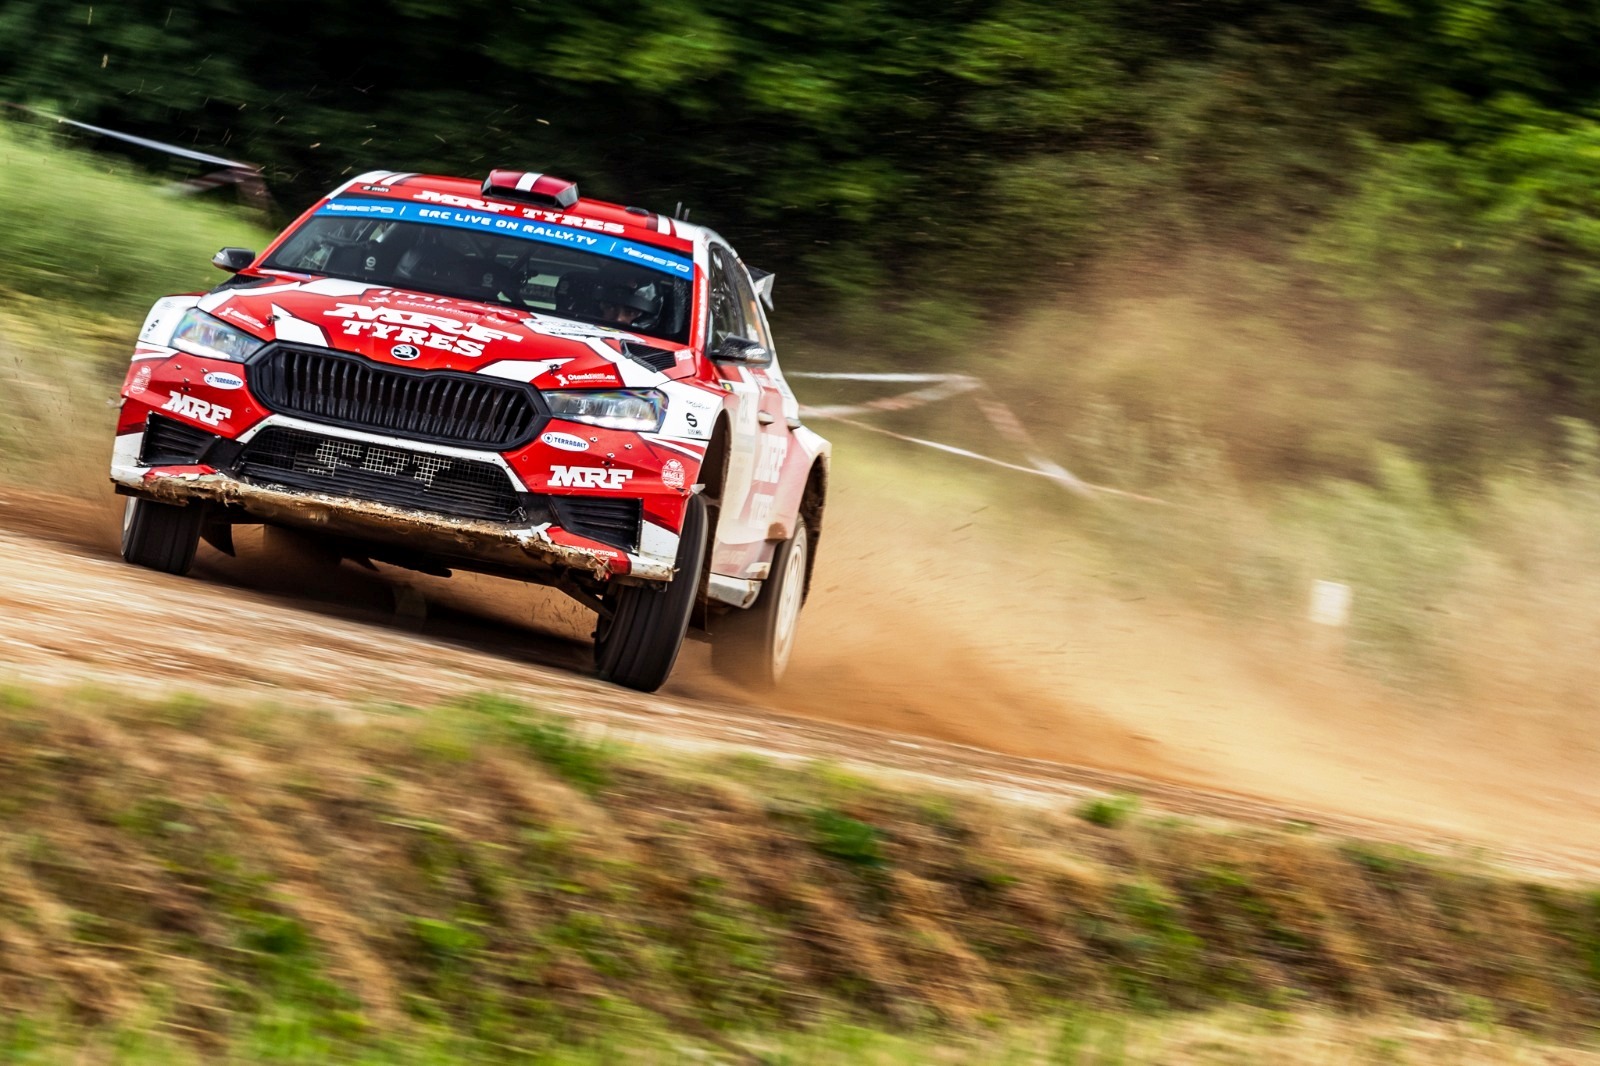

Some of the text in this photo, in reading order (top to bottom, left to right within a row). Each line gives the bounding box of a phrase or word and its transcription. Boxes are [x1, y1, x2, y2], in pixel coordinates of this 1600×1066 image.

[413, 190, 625, 234] MRF TYRES
[418, 209, 598, 246] ERC LIVE ON RALLY.TV
[323, 302, 524, 343] MRF
[341, 319, 486, 358] TYRES
[161, 390, 232, 427] MRF
[547, 465, 634, 490] MRF
